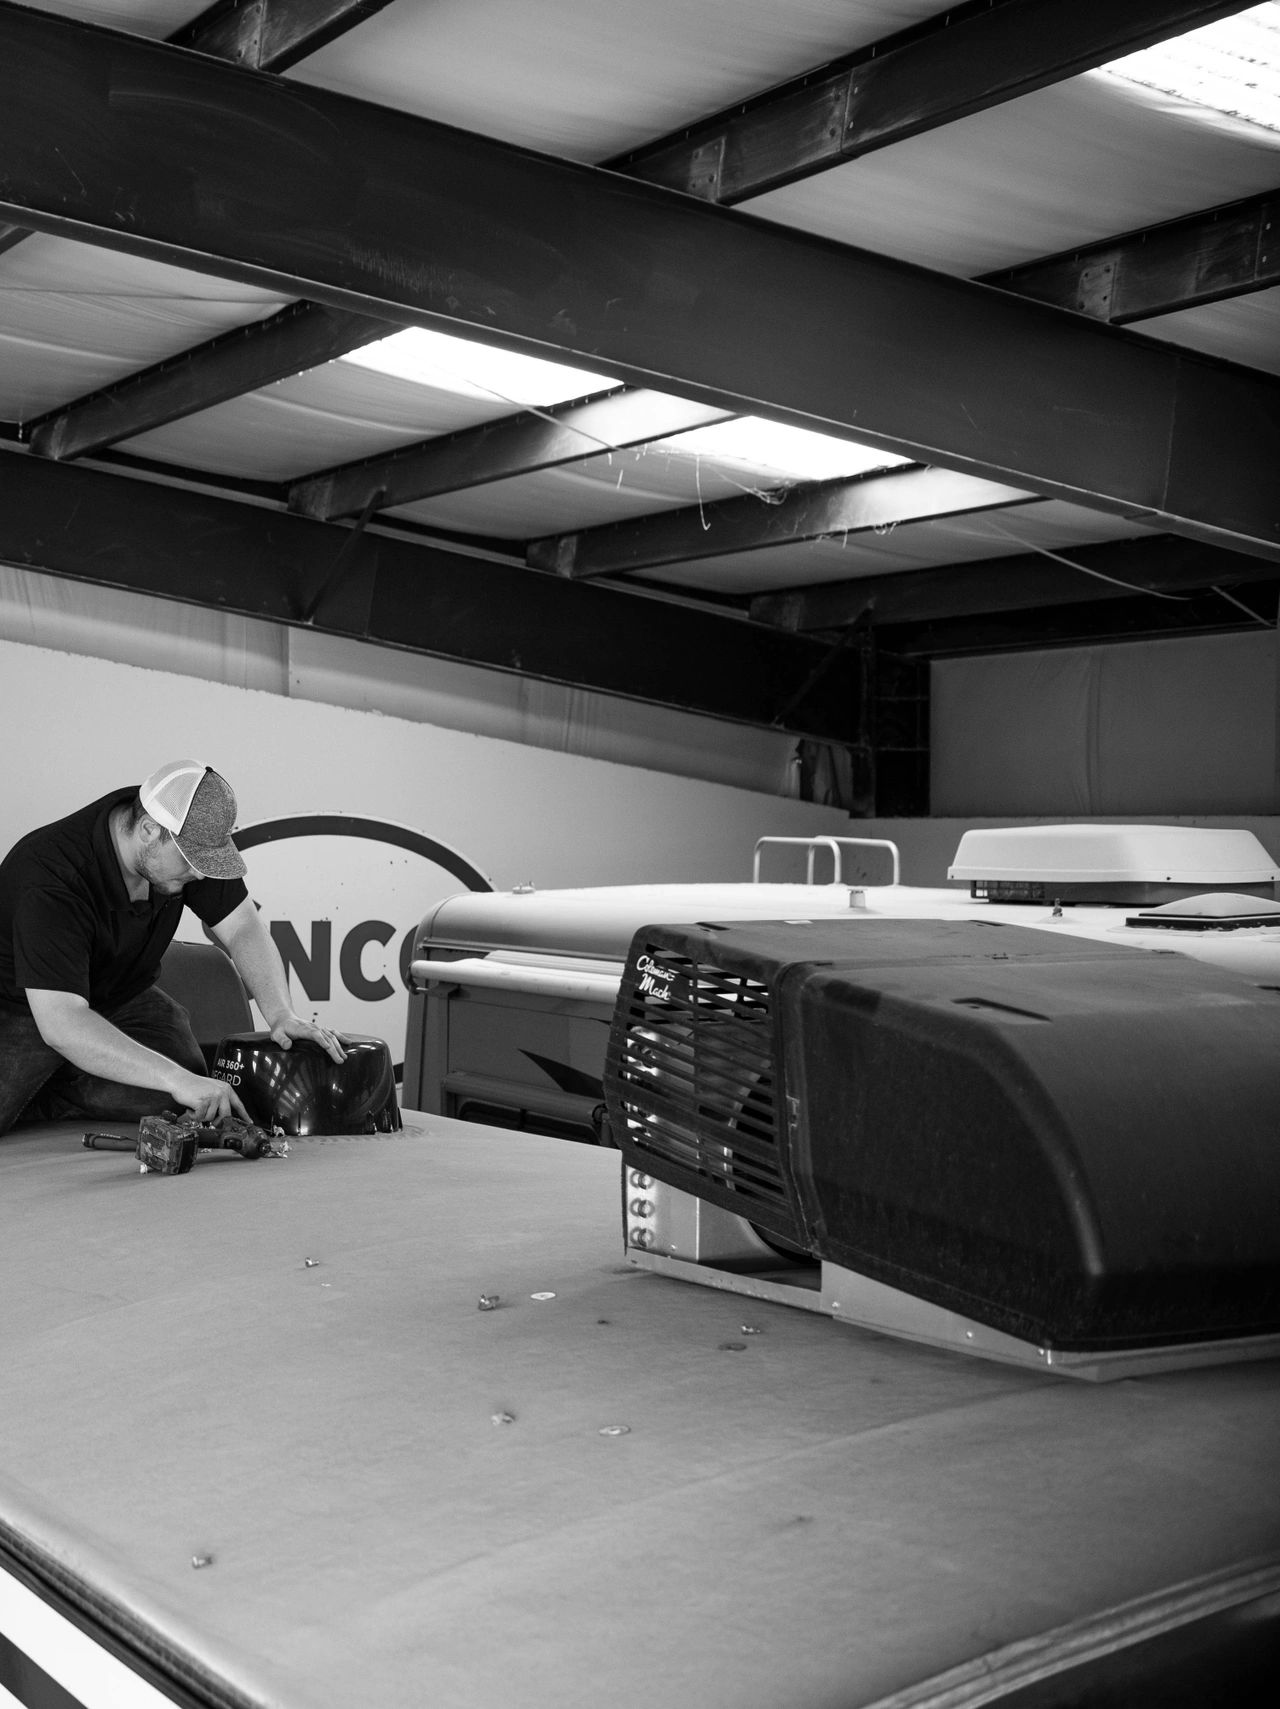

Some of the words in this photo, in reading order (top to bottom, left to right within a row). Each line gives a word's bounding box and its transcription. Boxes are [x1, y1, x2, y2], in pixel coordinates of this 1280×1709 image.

[636, 955, 675, 981] Coleman
[638, 973, 672, 1001] Mach
[226, 1059, 245, 1071] 360+
